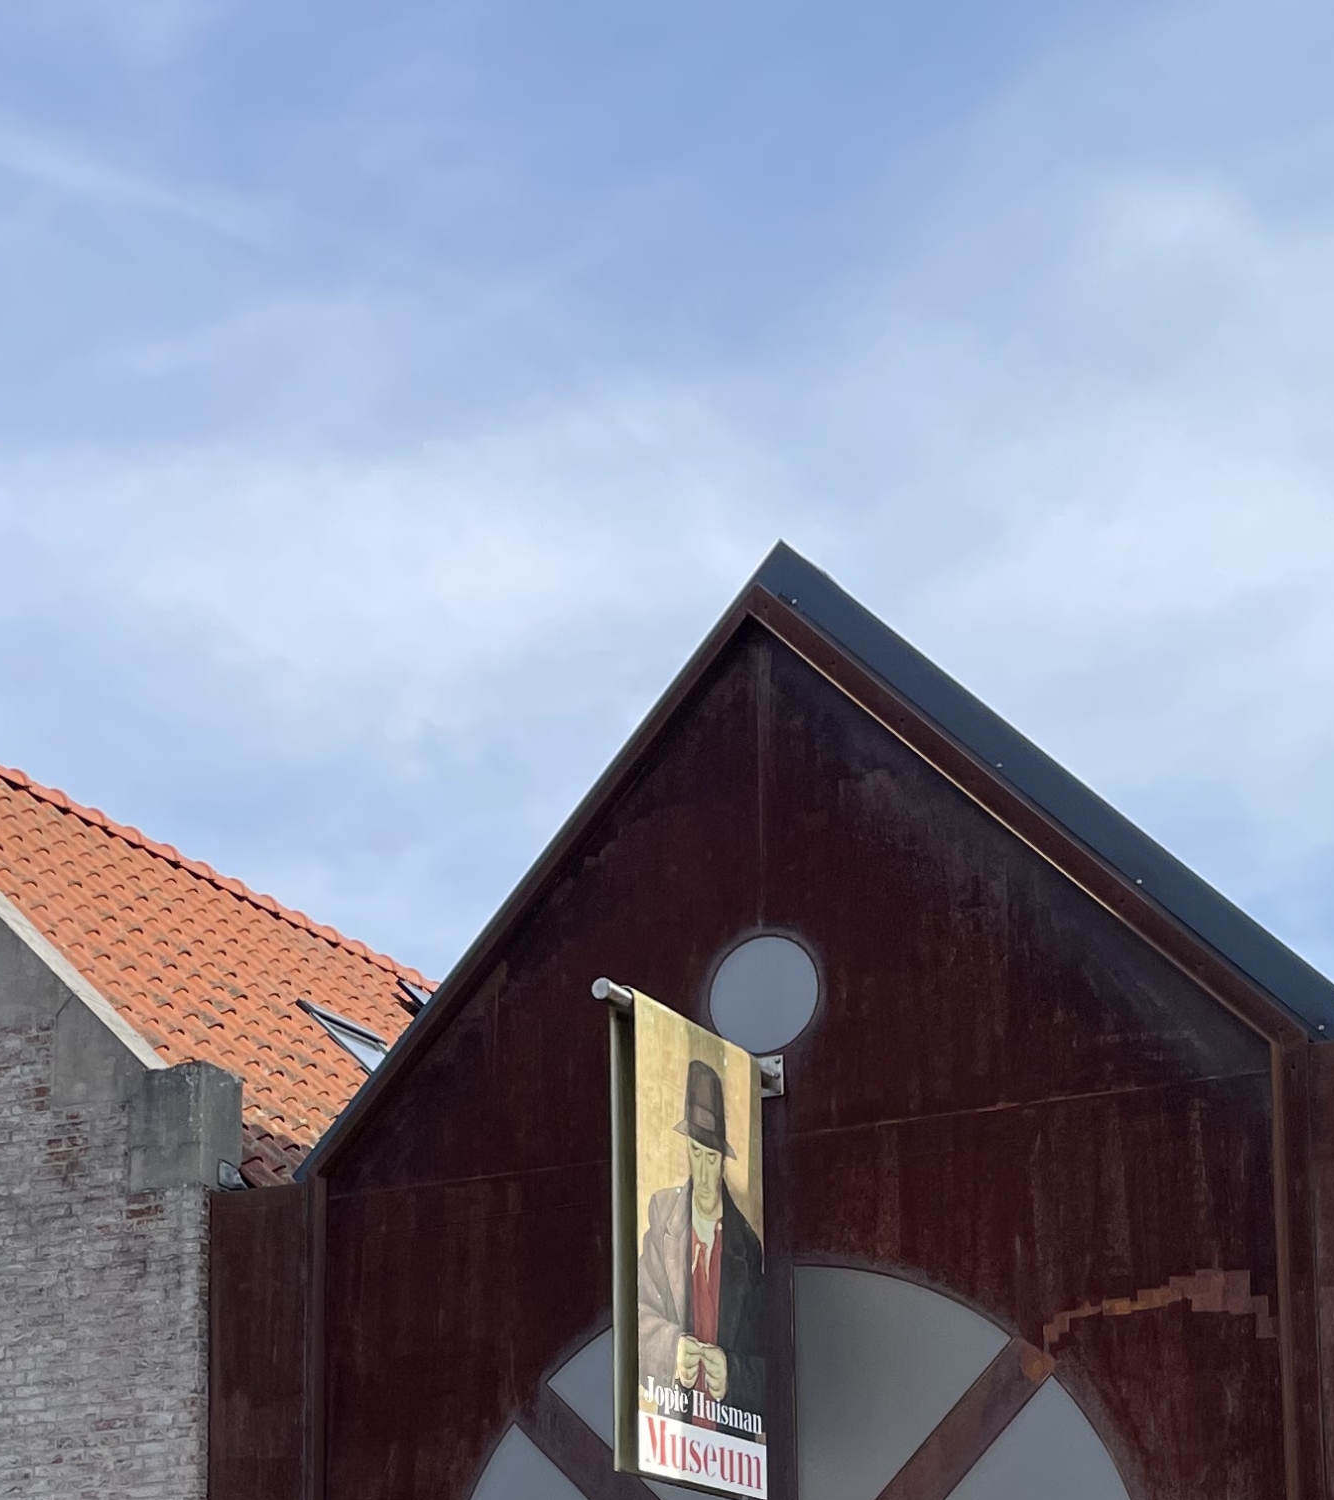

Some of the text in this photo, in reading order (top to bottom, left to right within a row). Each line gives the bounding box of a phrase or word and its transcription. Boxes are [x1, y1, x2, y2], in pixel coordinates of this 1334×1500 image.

[643, 1376, 763, 1434] Jopie Huisman
[645, 1415, 763, 1490] Museum
